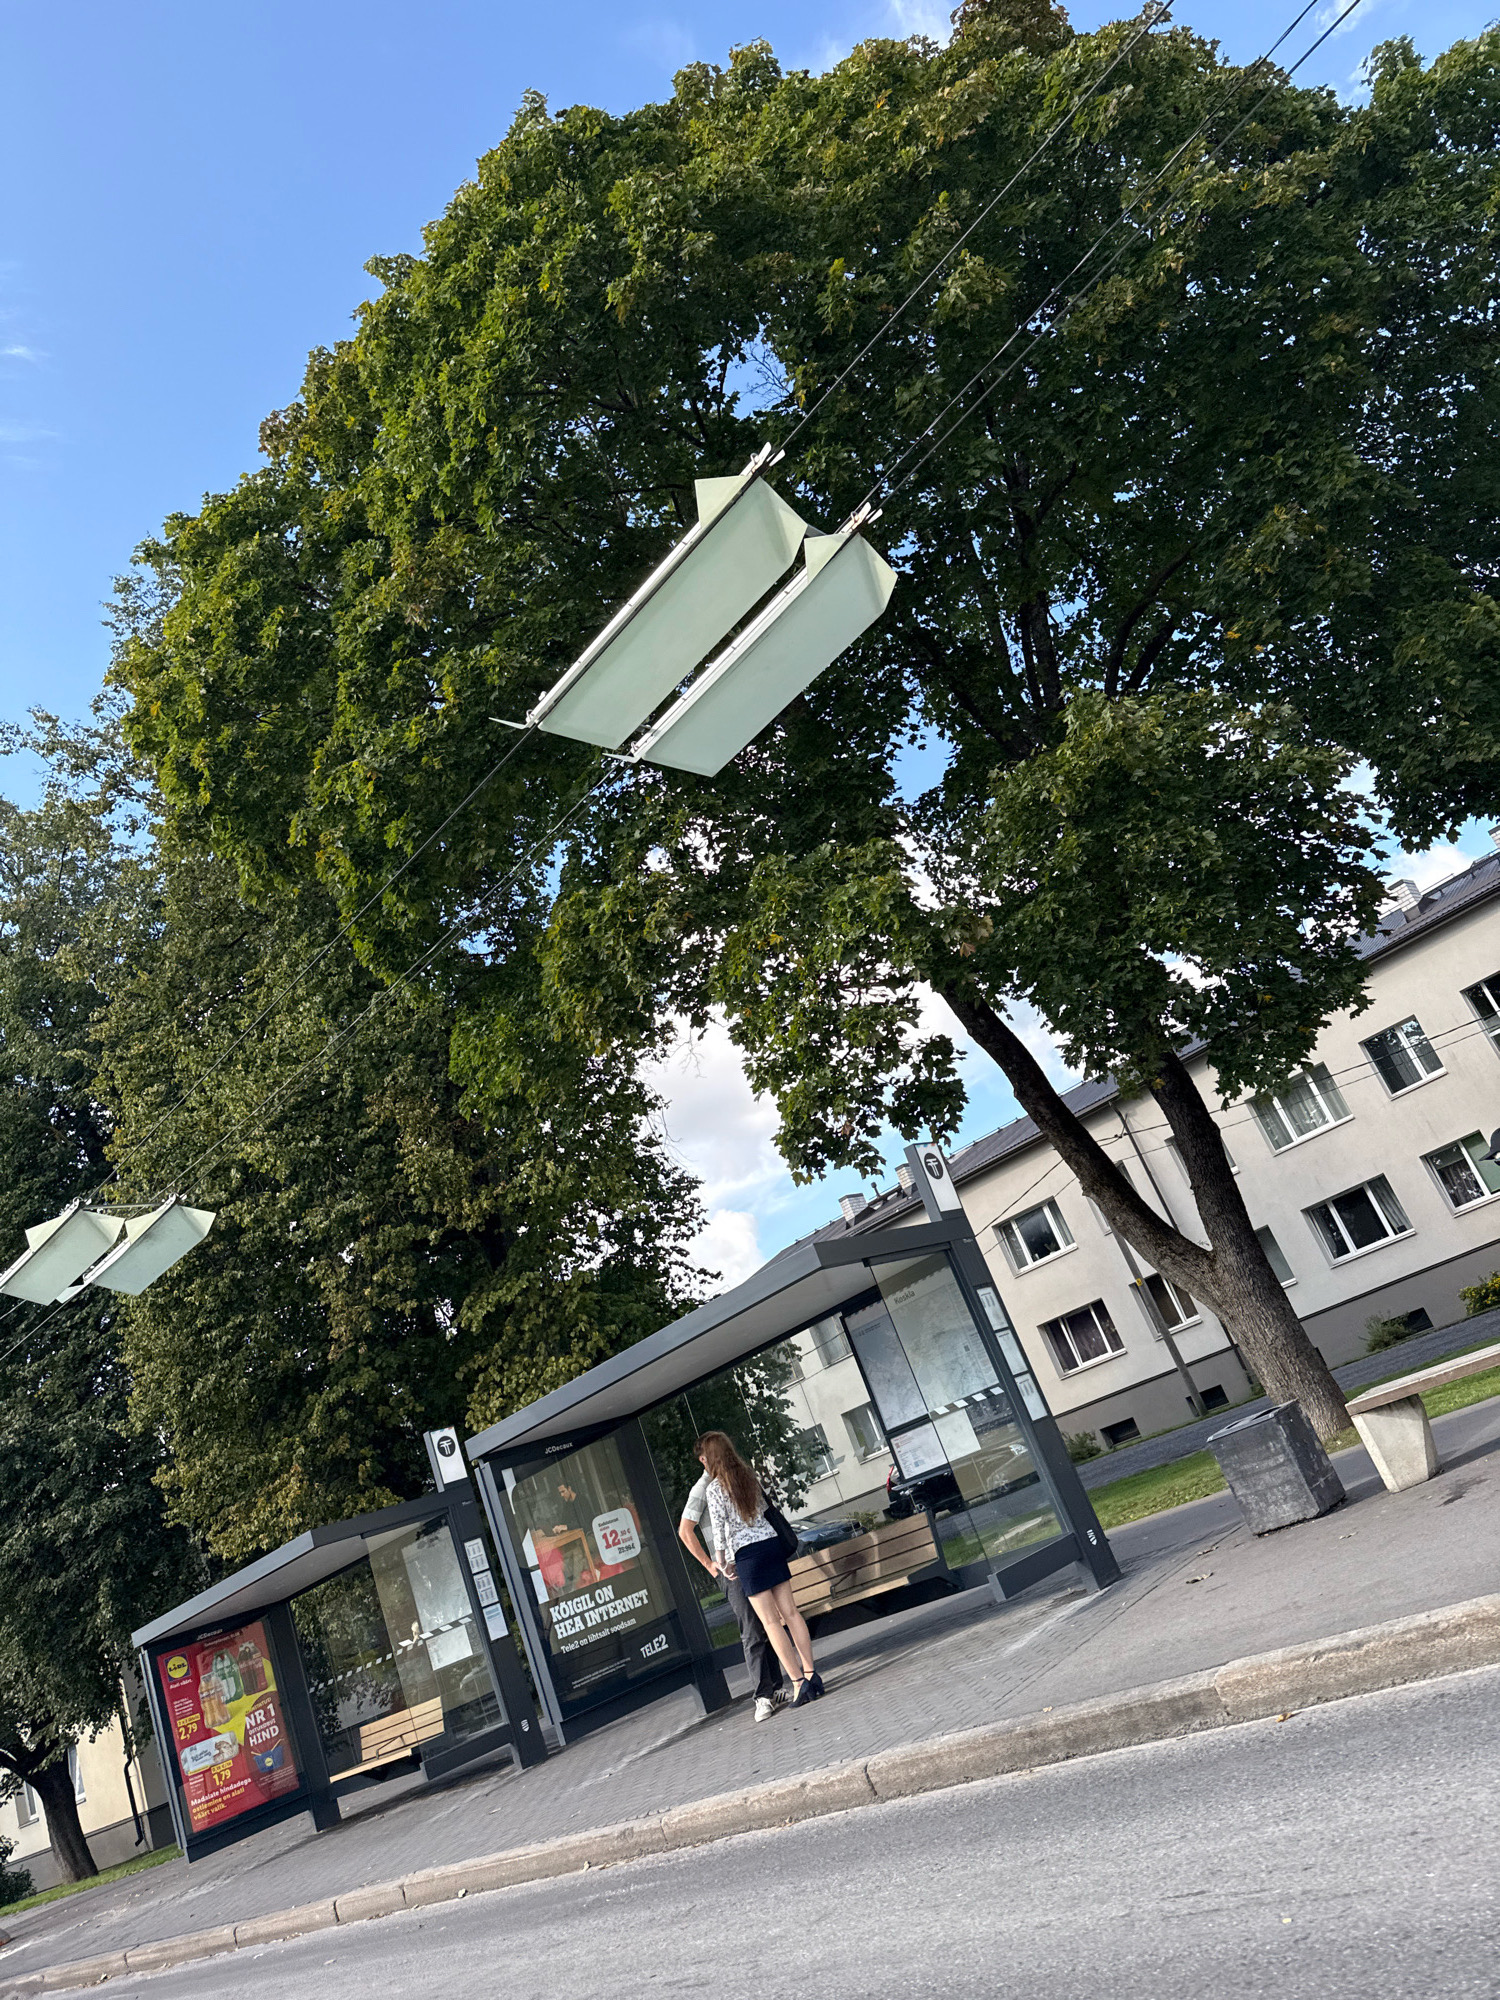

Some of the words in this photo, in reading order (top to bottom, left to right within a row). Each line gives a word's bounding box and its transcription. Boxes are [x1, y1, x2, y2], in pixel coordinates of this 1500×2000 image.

[893, 1289, 916, 1304] Koskla
[545, 1442, 573, 1454] JCDecaux
[550, 1593, 596, 1622] KÕIGIL
[594, 1585, 615, 1604] ON
[554, 1616, 585, 1639] HEA
[584, 1589, 649, 1628] INTERNET
[561, 1640, 580, 1654] Tele2
[580, 1638, 588, 1646] on
[587, 1628, 610, 1643] lihtsalt
[610, 1618, 637, 1634] soodsam
[640, 1633, 669, 1659] TELE2
[245, 1708, 266, 1729] NR
[267, 1703, 276, 1717] 1
[248, 1718, 276, 1736] OSTUKORVI
[178, 1722, 198, 1740] 2,79
[249, 1725, 280, 1747] HIND
[213, 1769, 231, 1787] 1,79
[190, 1791, 219, 1806] Madalate
[219, 1777, 252, 1793] hindadega
[192, 1797, 222, 1813] ostlemine
